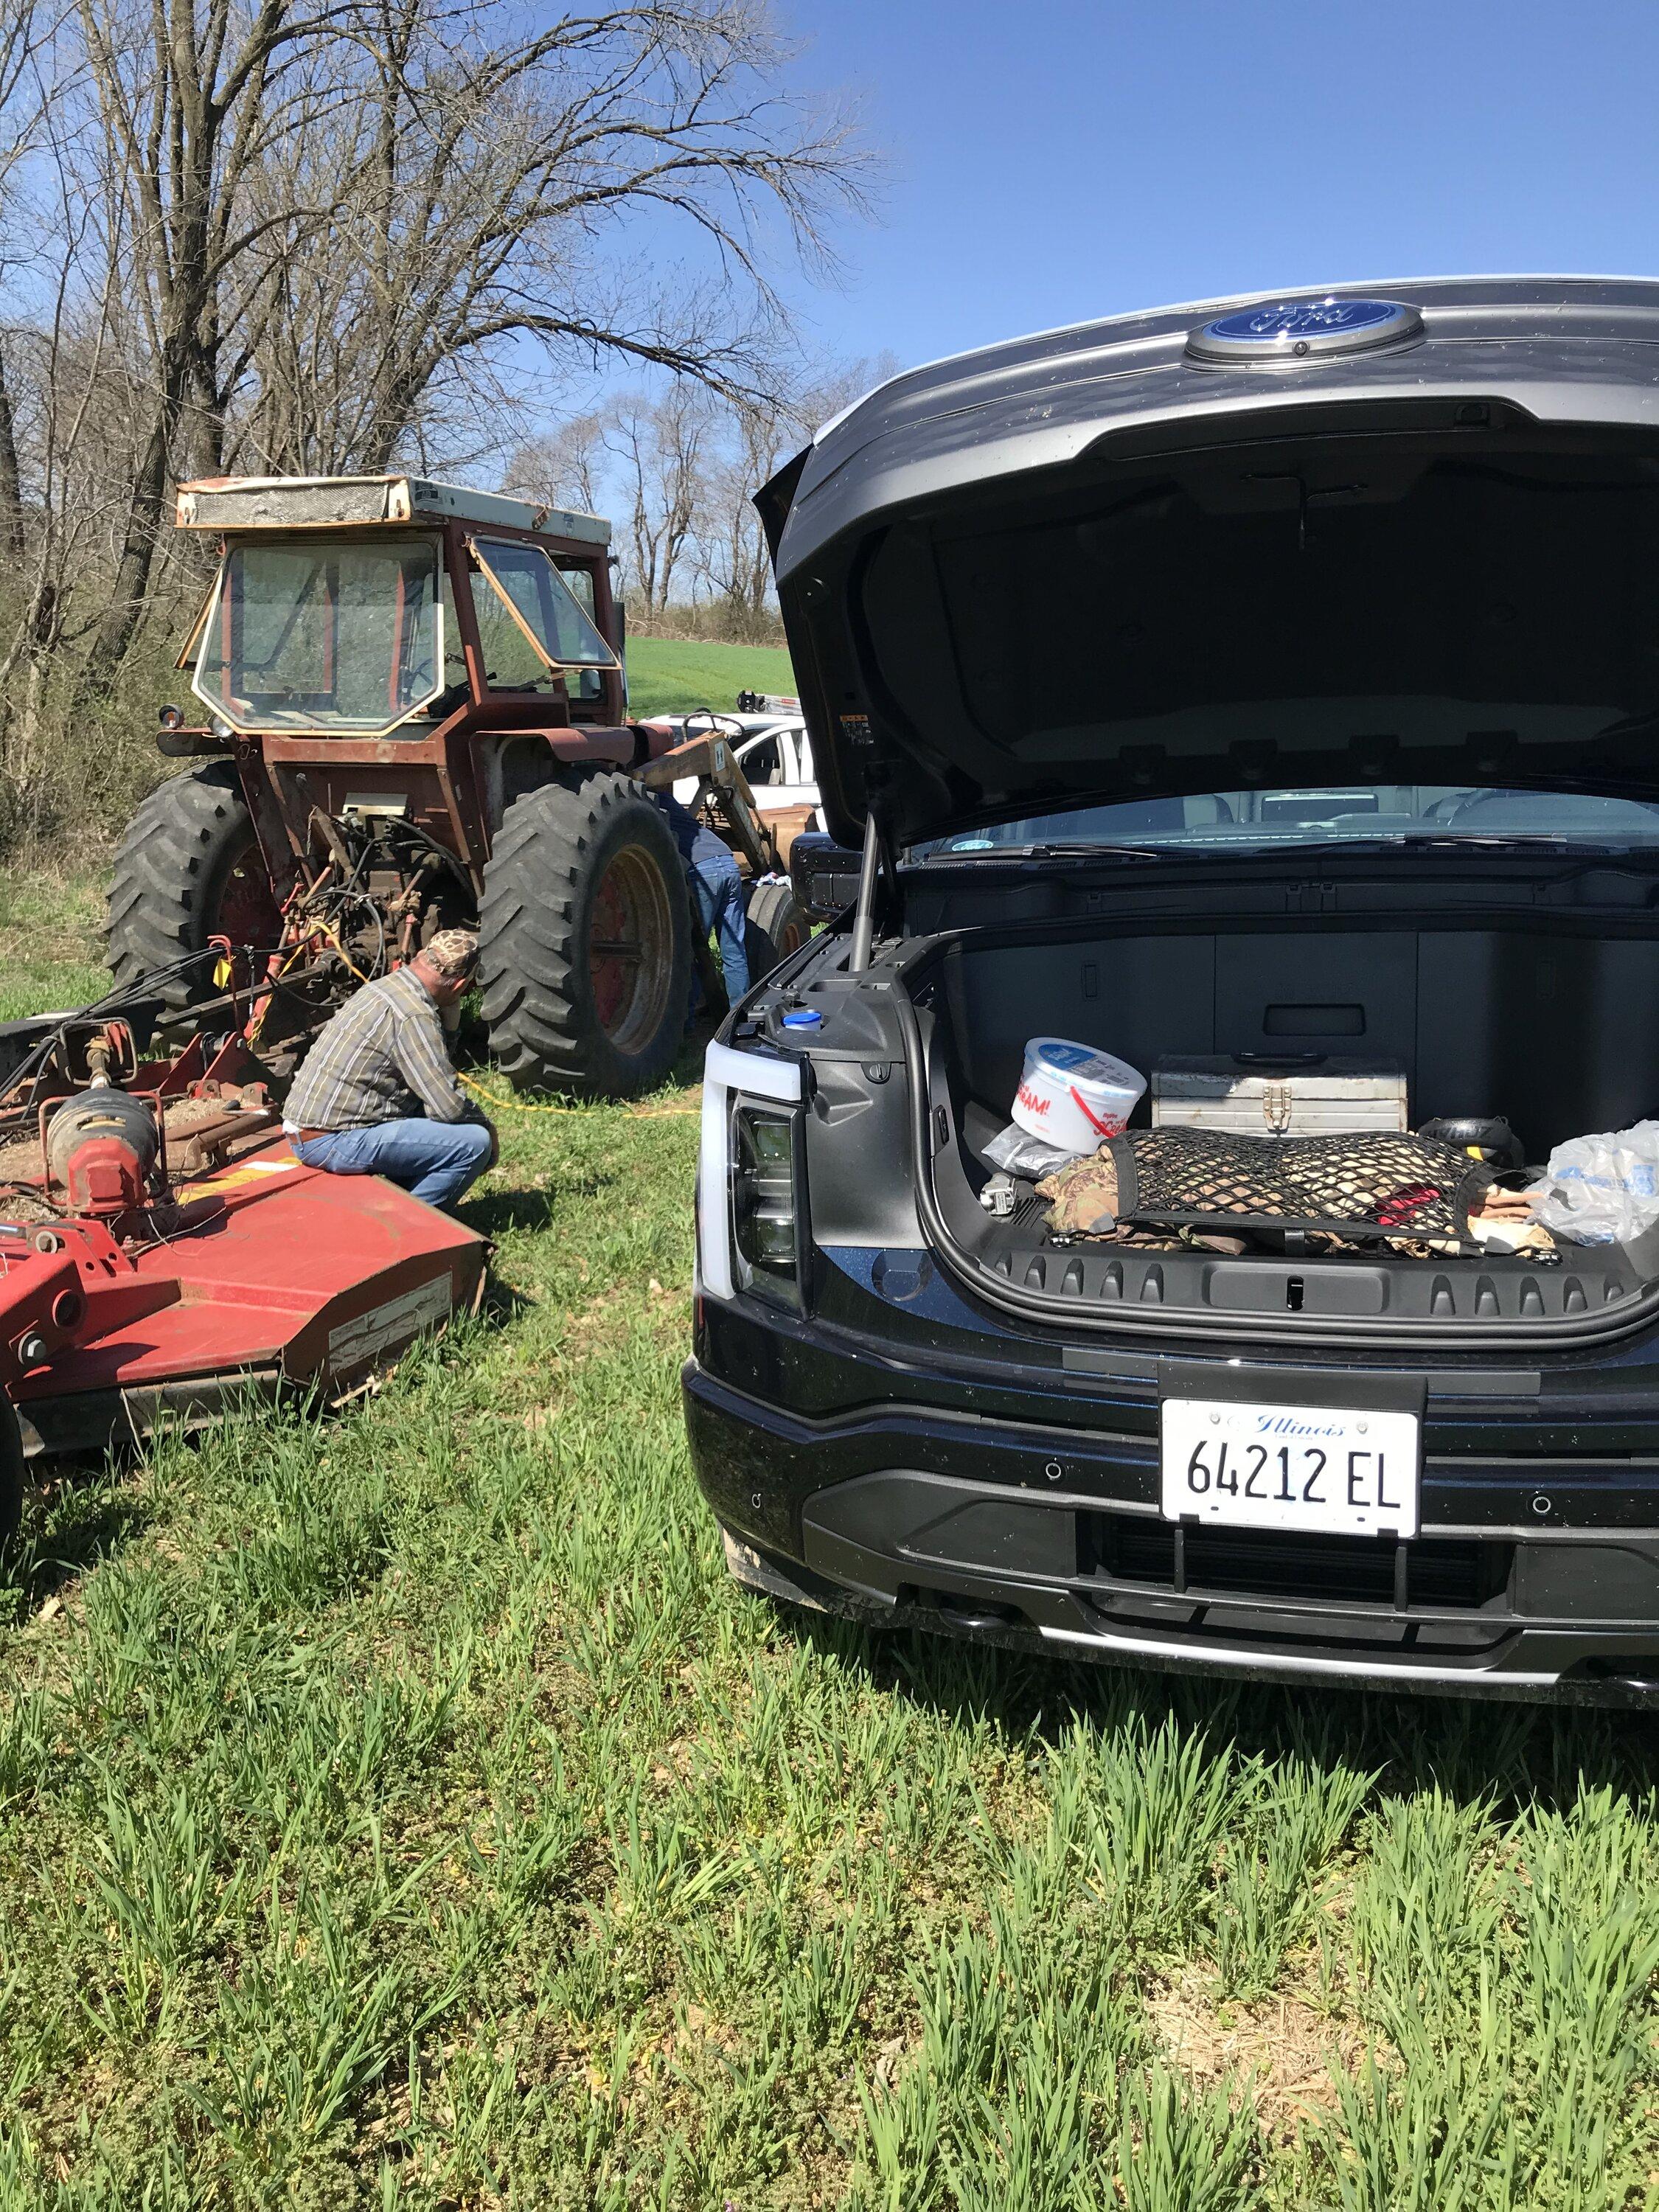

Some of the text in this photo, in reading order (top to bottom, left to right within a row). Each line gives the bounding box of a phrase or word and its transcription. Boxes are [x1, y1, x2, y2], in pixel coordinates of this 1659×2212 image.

[1249, 305, 1356, 331] Ford
[1254, 1414, 1346, 1437] Illinois
[1187, 1440, 1401, 1509] 64212 EL
